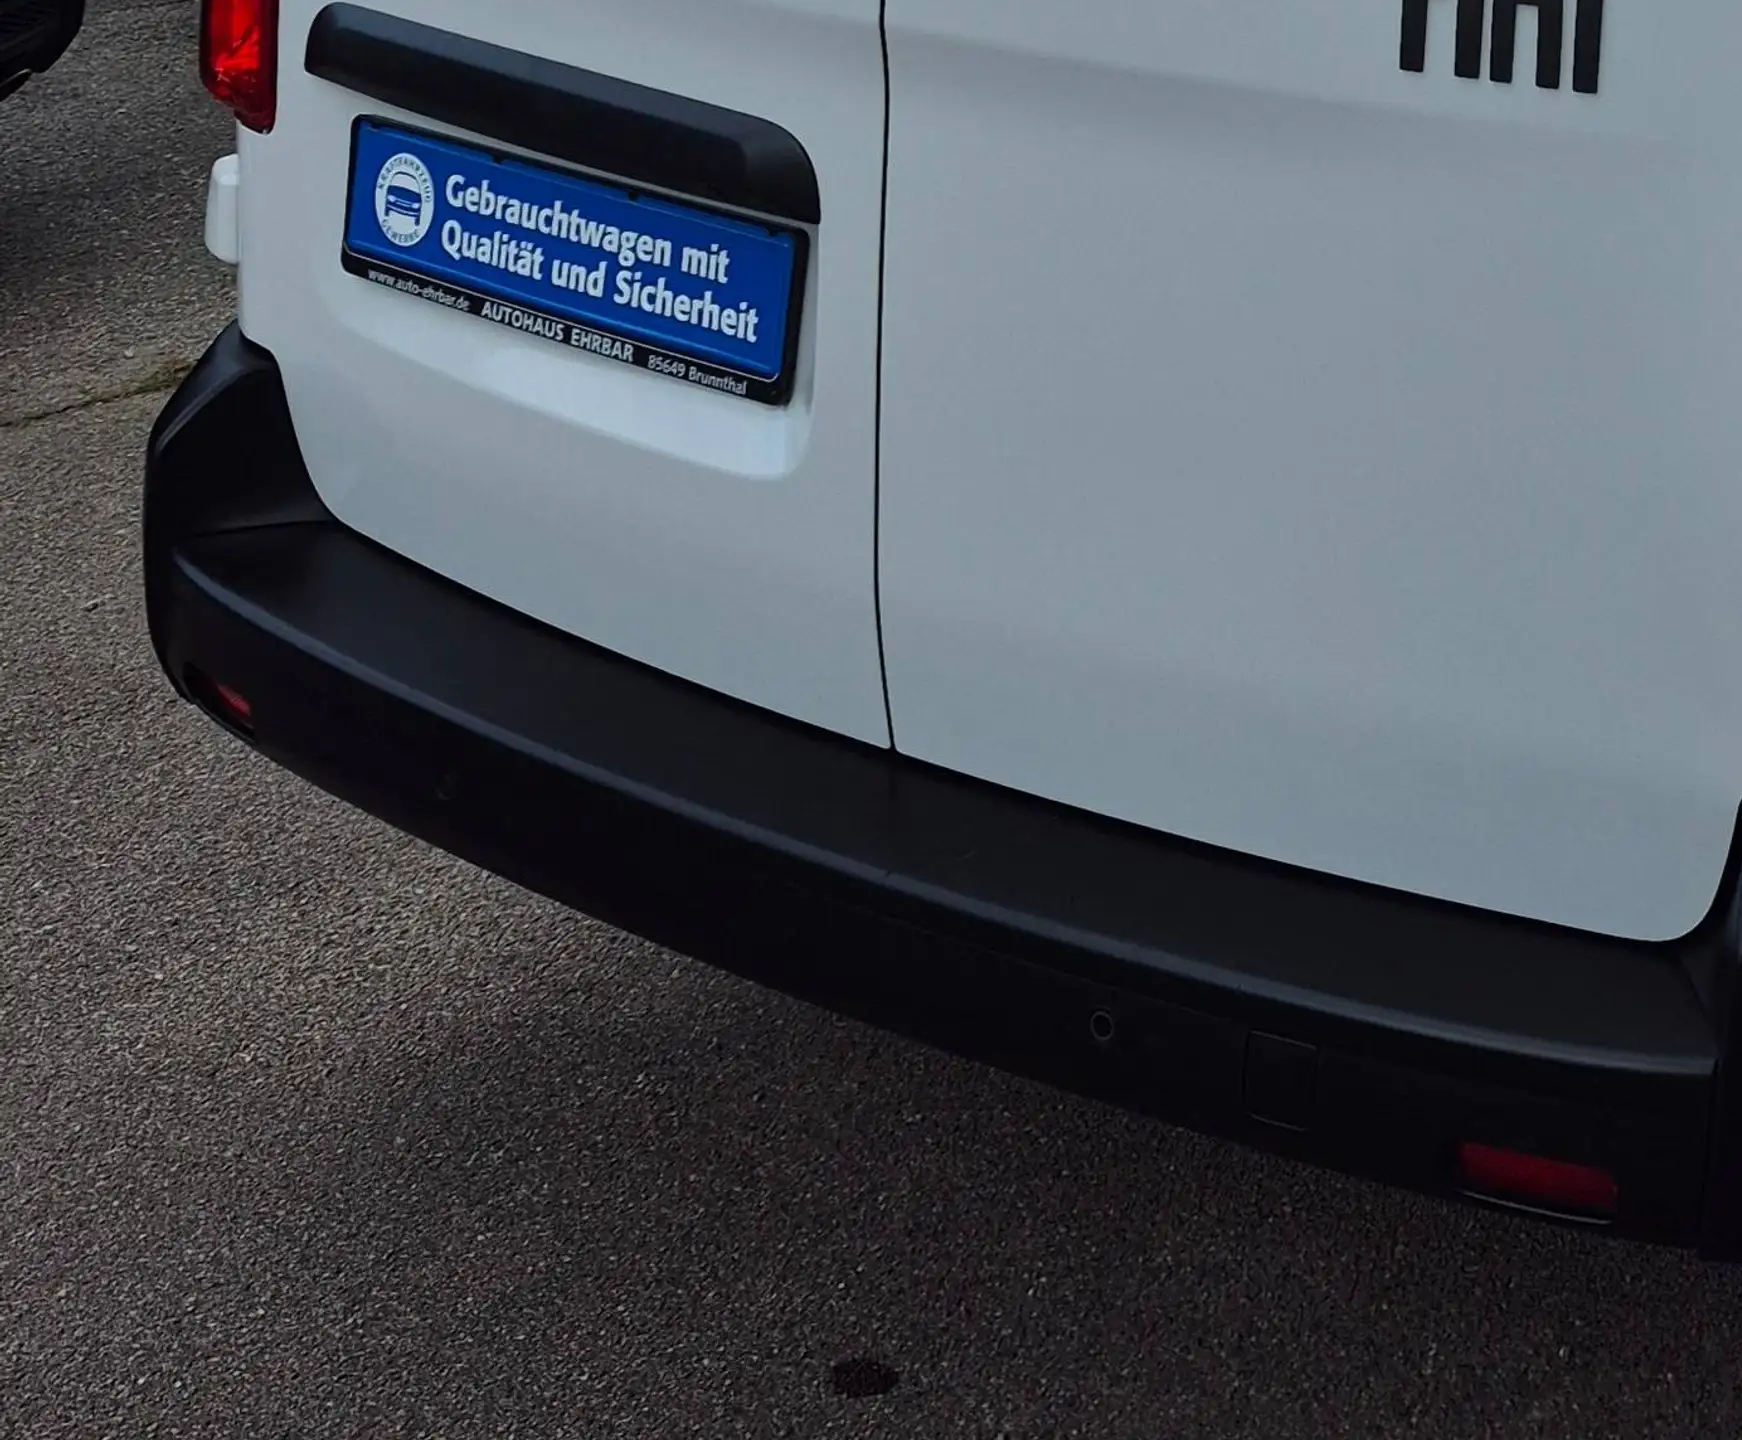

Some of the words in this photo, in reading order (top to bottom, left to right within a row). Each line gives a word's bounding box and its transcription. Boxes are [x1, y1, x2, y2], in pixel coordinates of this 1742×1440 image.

[441, 219, 546, 281] Qualität
[551, 259, 608, 298] und
[613, 270, 760, 344] Sicherheit
[445, 174, 673, 267] Gebrauchtwagen
[681, 243, 731, 284] mit
[367, 269, 473, 312] www.auto-ehrbar.de
[480, 301, 564, 341] AUTOHAUS
[570, 328, 635, 363] EHRBAR
[648, 354, 686, 378] 85649
[688, 365, 748, 396] Brunnthal
